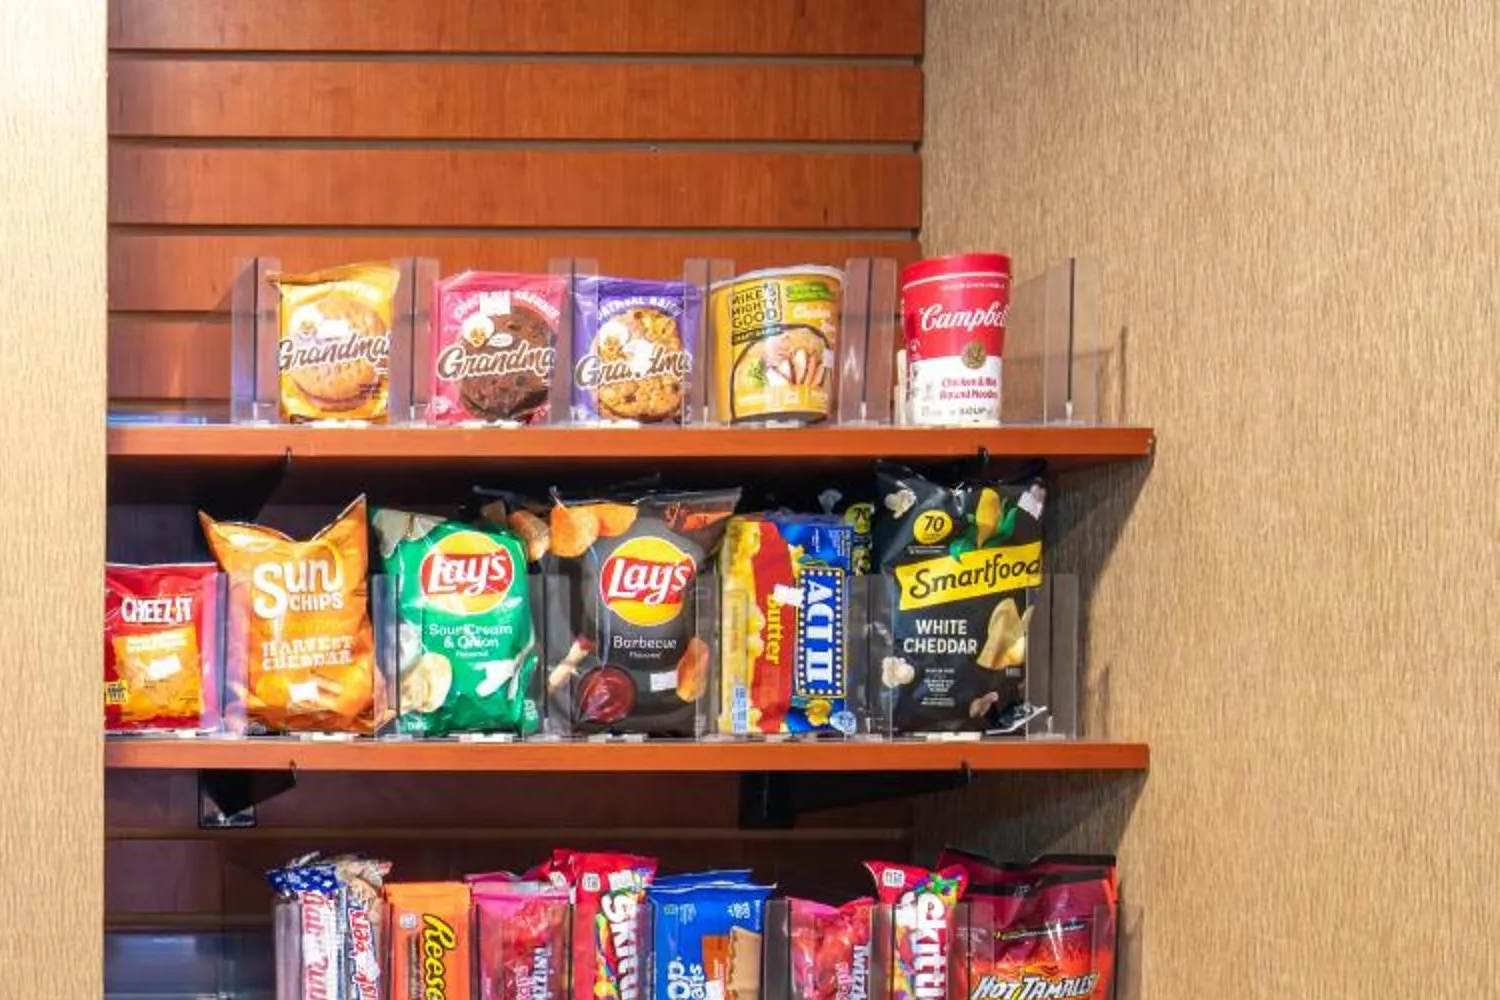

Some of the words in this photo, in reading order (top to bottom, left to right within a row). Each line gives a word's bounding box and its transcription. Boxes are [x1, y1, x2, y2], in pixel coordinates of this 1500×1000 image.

[923, 515, 945, 533] 70
[427, 552, 507, 597] Lay's
[607, 558, 693, 606] Lay's
[909, 552, 1041, 599] Smartfood
[288, 591, 345, 612] CHIPS
[428, 623, 465, 637] Sour
[466, 623, 513, 637] Cream
[915, 619, 968, 636] WHITE
[261, 635, 354, 658] HARVEST
[612, 635, 677, 650] Barbecue
[903, 638, 978, 655] CHEDDAR
[261, 650, 352, 671] CHEDDAR
